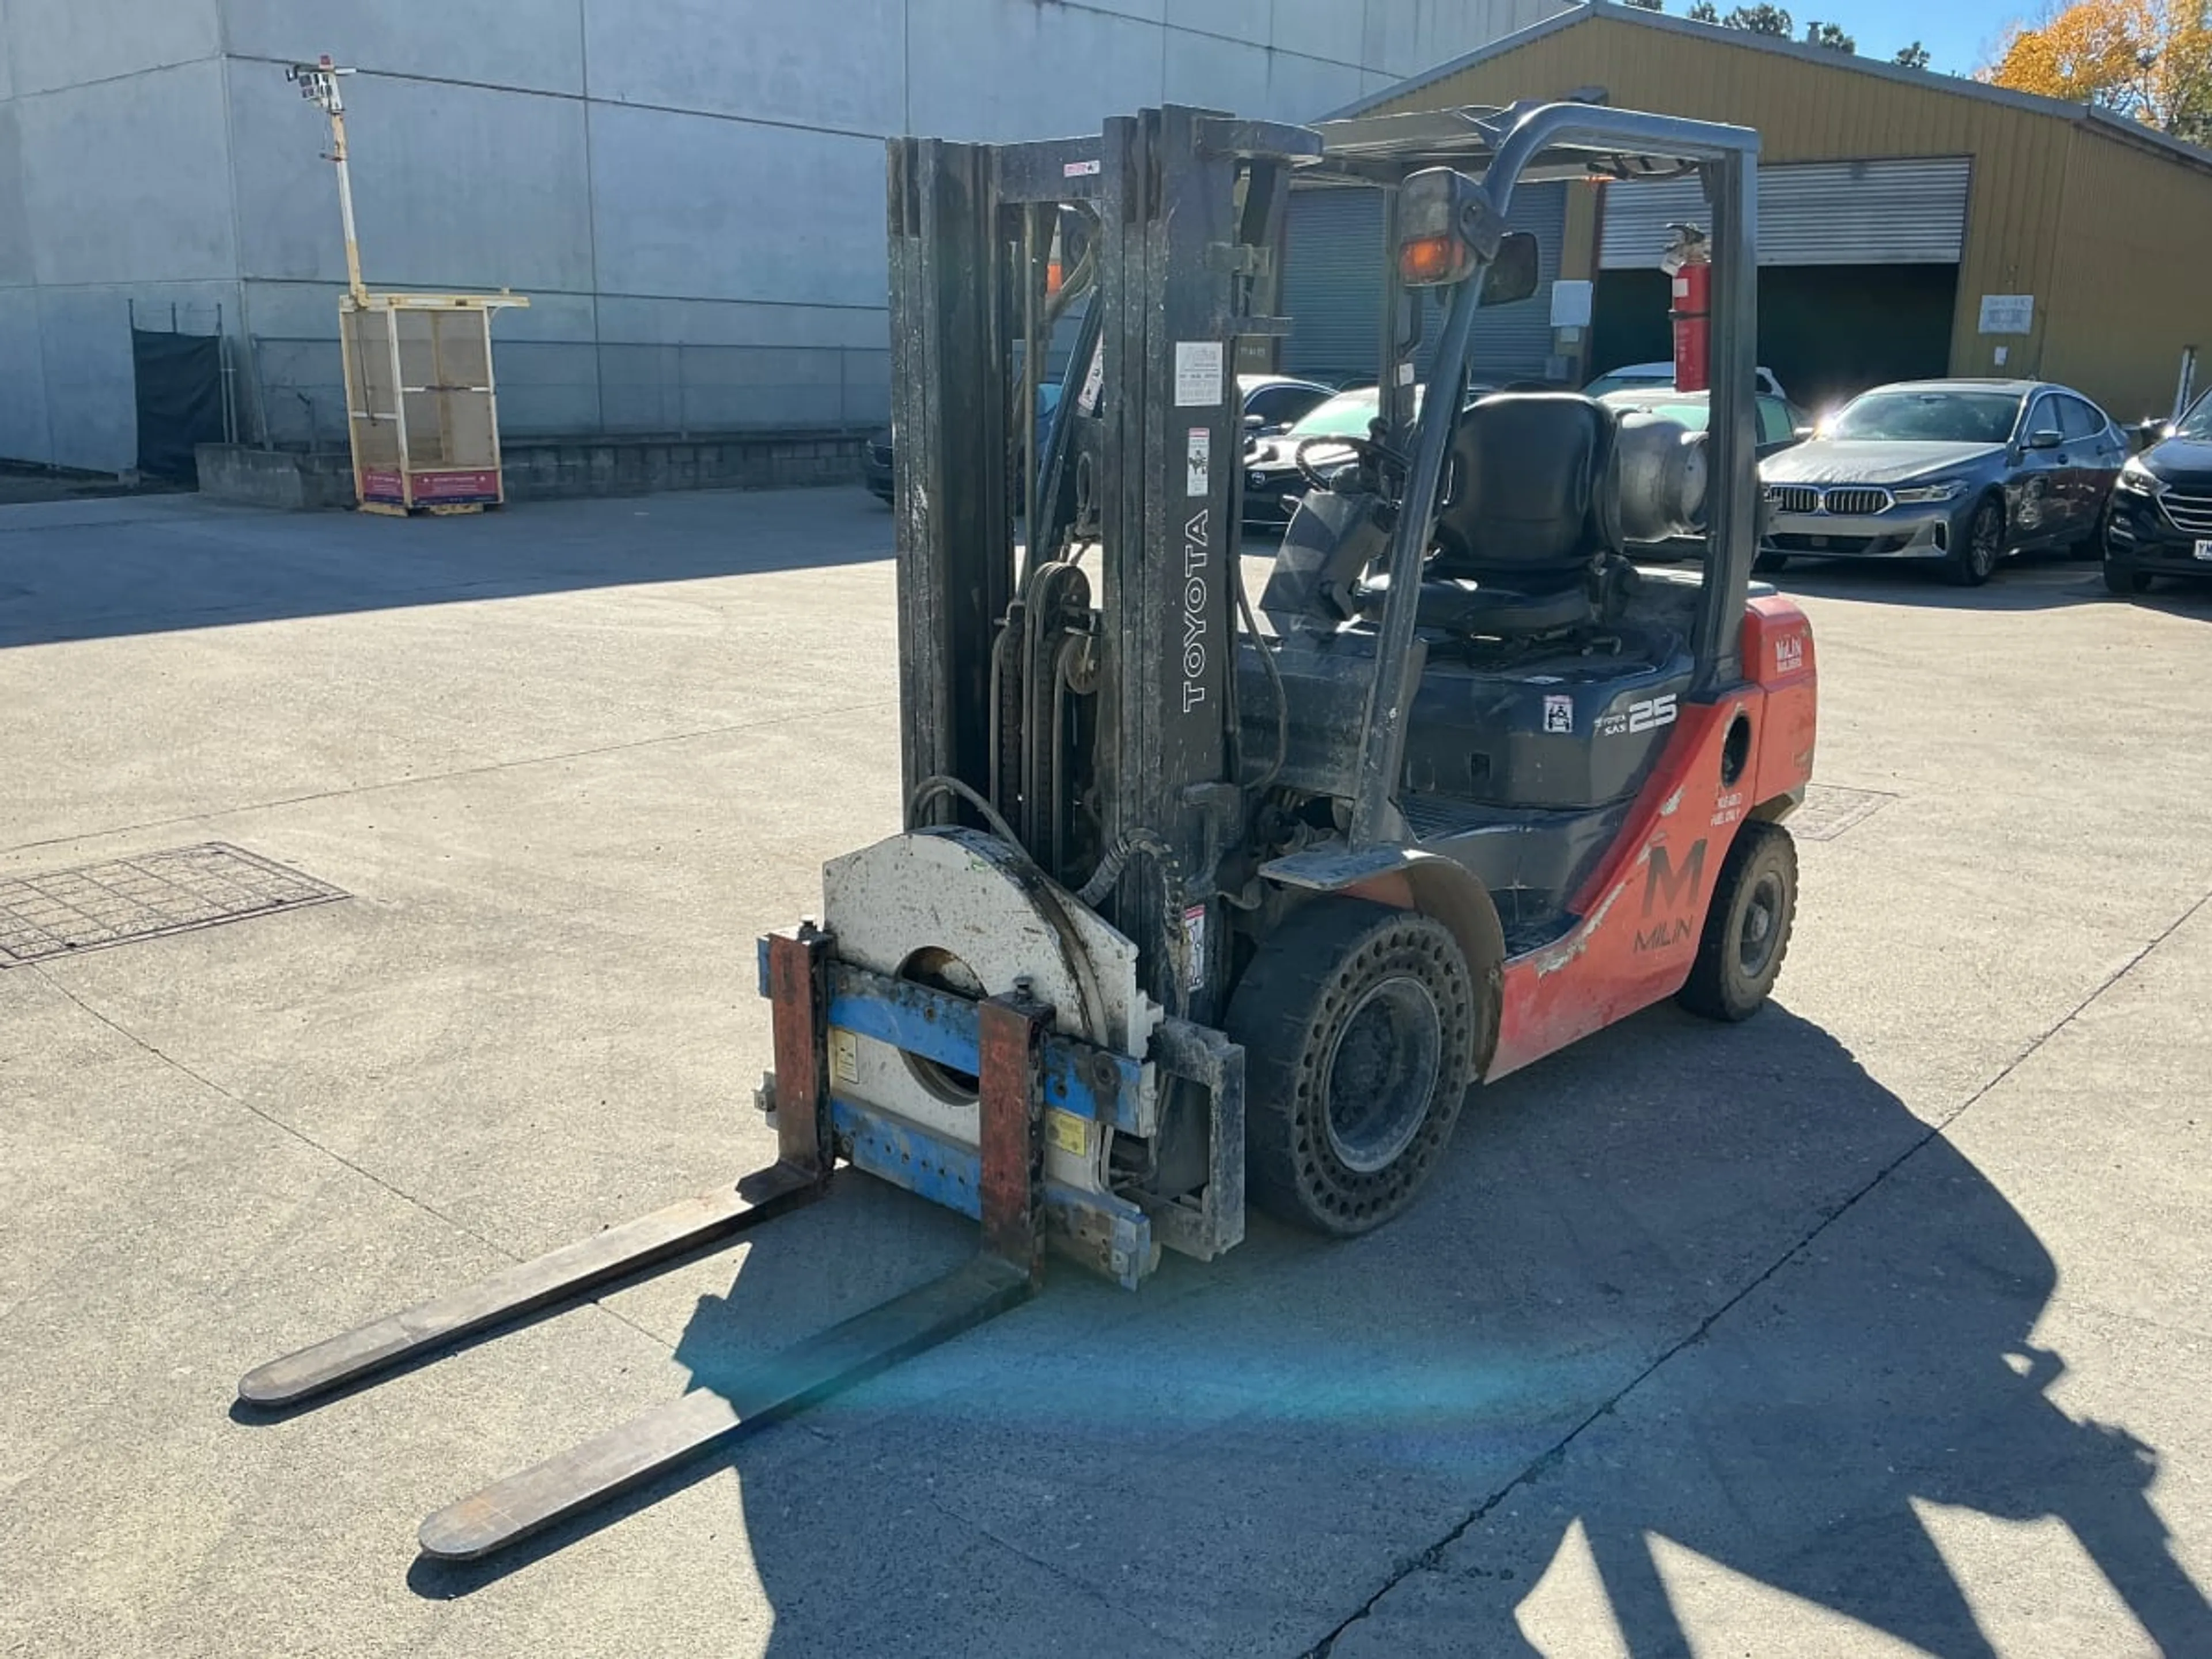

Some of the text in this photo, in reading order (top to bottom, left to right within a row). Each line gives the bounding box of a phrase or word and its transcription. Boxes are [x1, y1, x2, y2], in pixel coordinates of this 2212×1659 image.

[1183, 509, 1209, 713] TOYOTA
[1629, 693, 1677, 734] 25
[1642, 839, 1708, 918] M
[1633, 914, 1694, 953] MILIN
